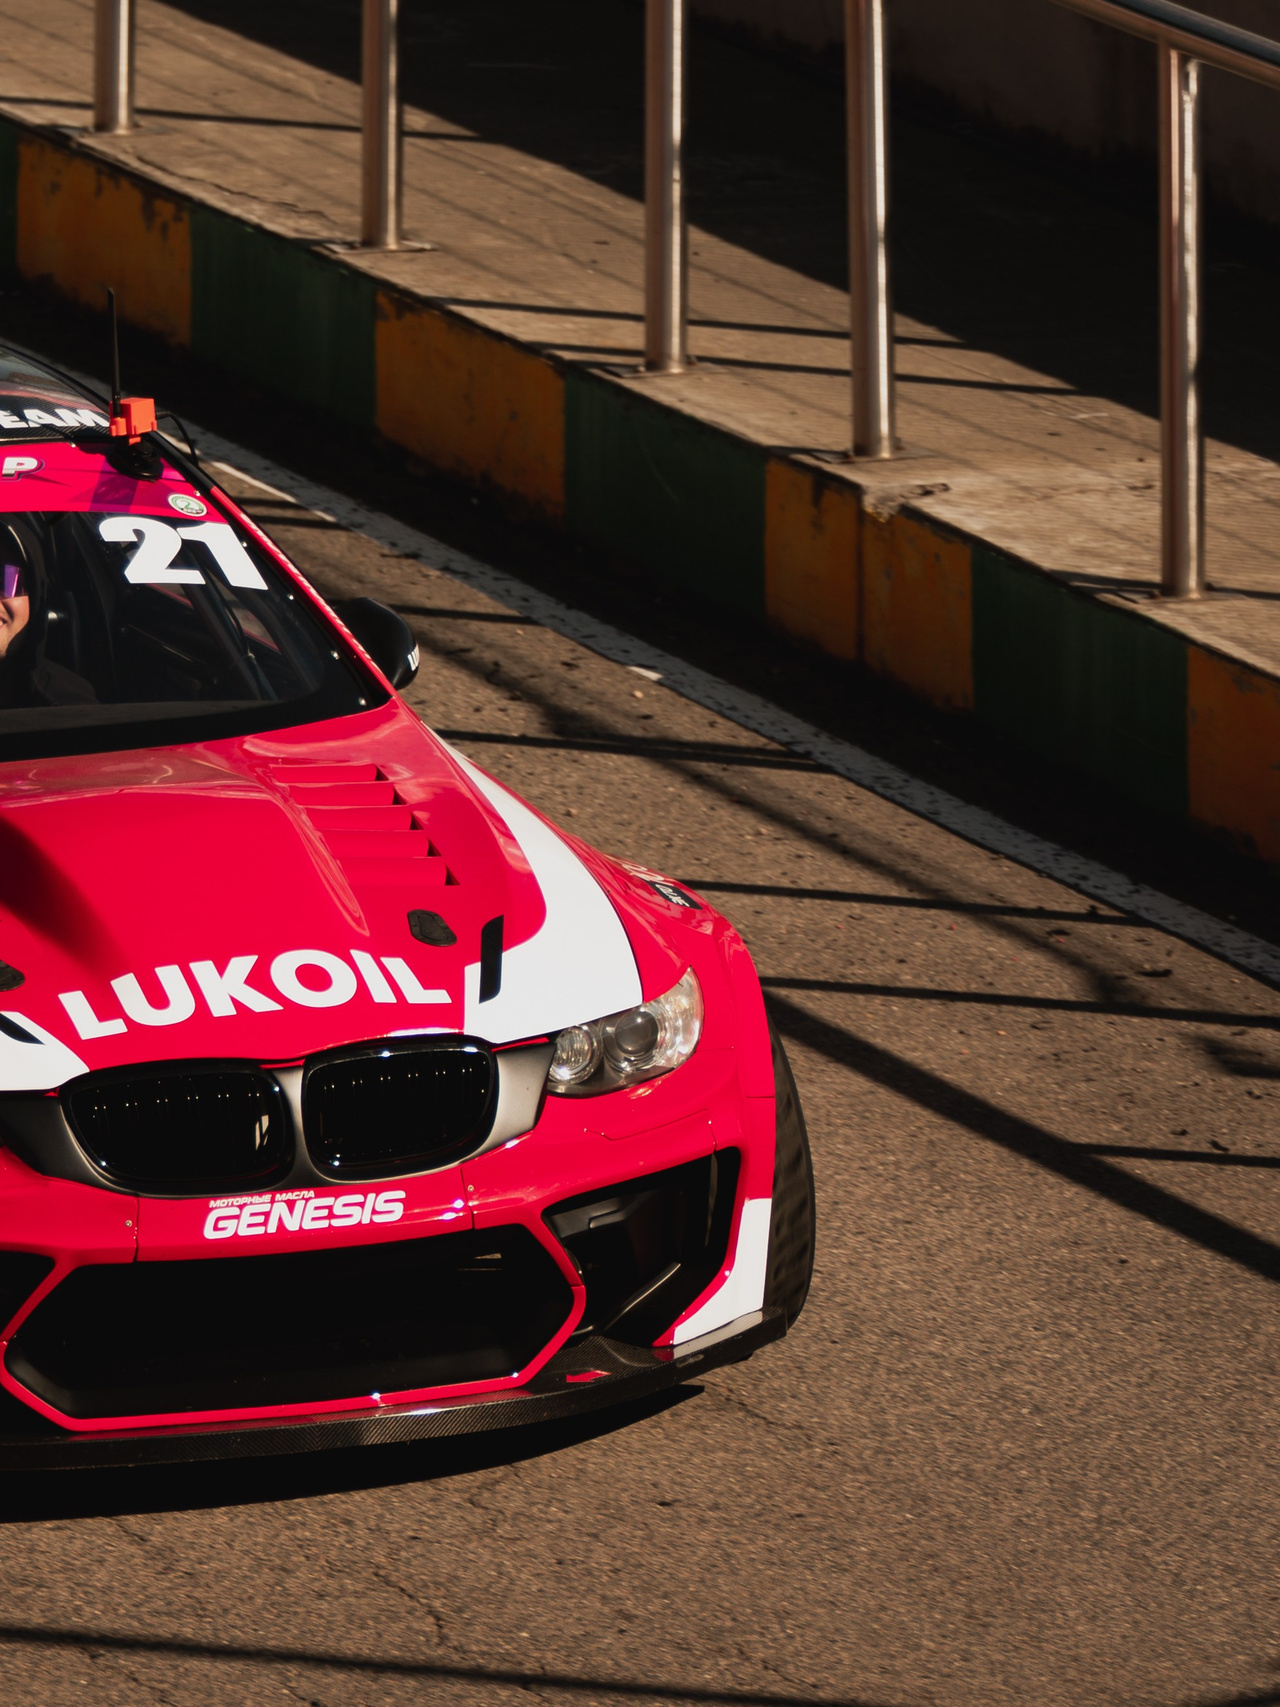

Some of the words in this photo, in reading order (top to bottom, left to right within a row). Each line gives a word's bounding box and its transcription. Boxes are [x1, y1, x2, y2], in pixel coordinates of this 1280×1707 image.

[98, 516, 269, 590] 21
[58, 948, 452, 1041] LUKOIL
[203, 1190, 406, 1240] GENESIS
[209, 1194, 272, 1208] МОТОРНЫЕ
[275, 1190, 315, 1201] МАСЛА
